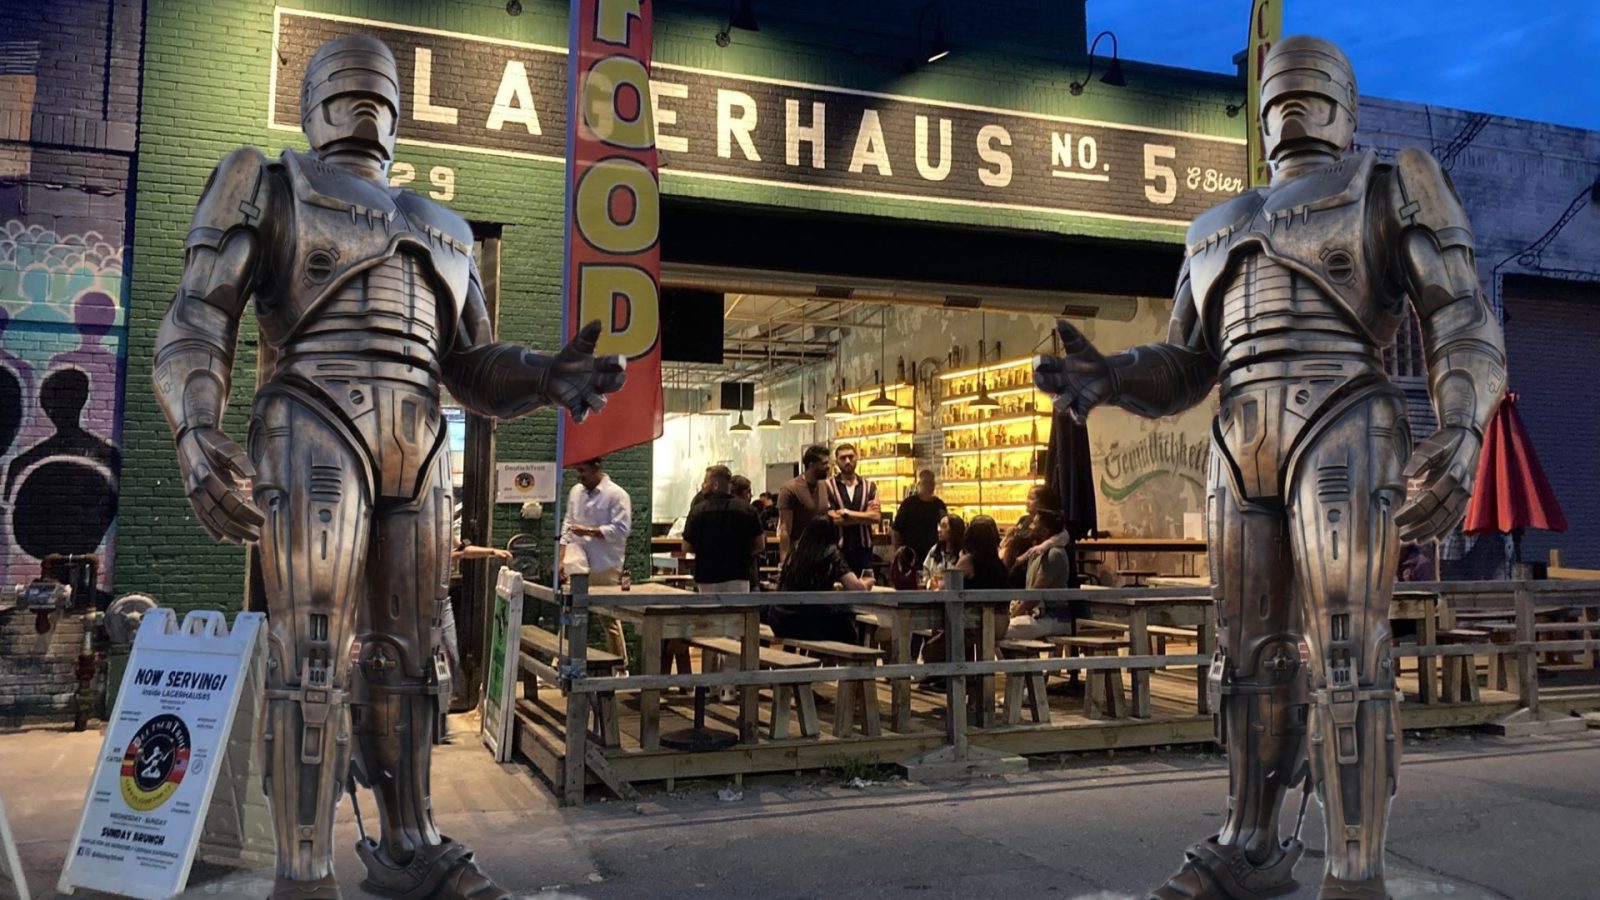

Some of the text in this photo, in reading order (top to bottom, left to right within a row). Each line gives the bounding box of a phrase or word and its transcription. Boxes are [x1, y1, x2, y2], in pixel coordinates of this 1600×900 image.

[1051, 131, 1110, 171] NO.
[1143, 143, 1178, 205] 5
[1203, 168, 1244, 194] Bier
[134, 668, 227, 691] NOW SERVING!
[101, 827, 131, 841] SUNDAY
[133, 831, 166, 846] BRUNCH
